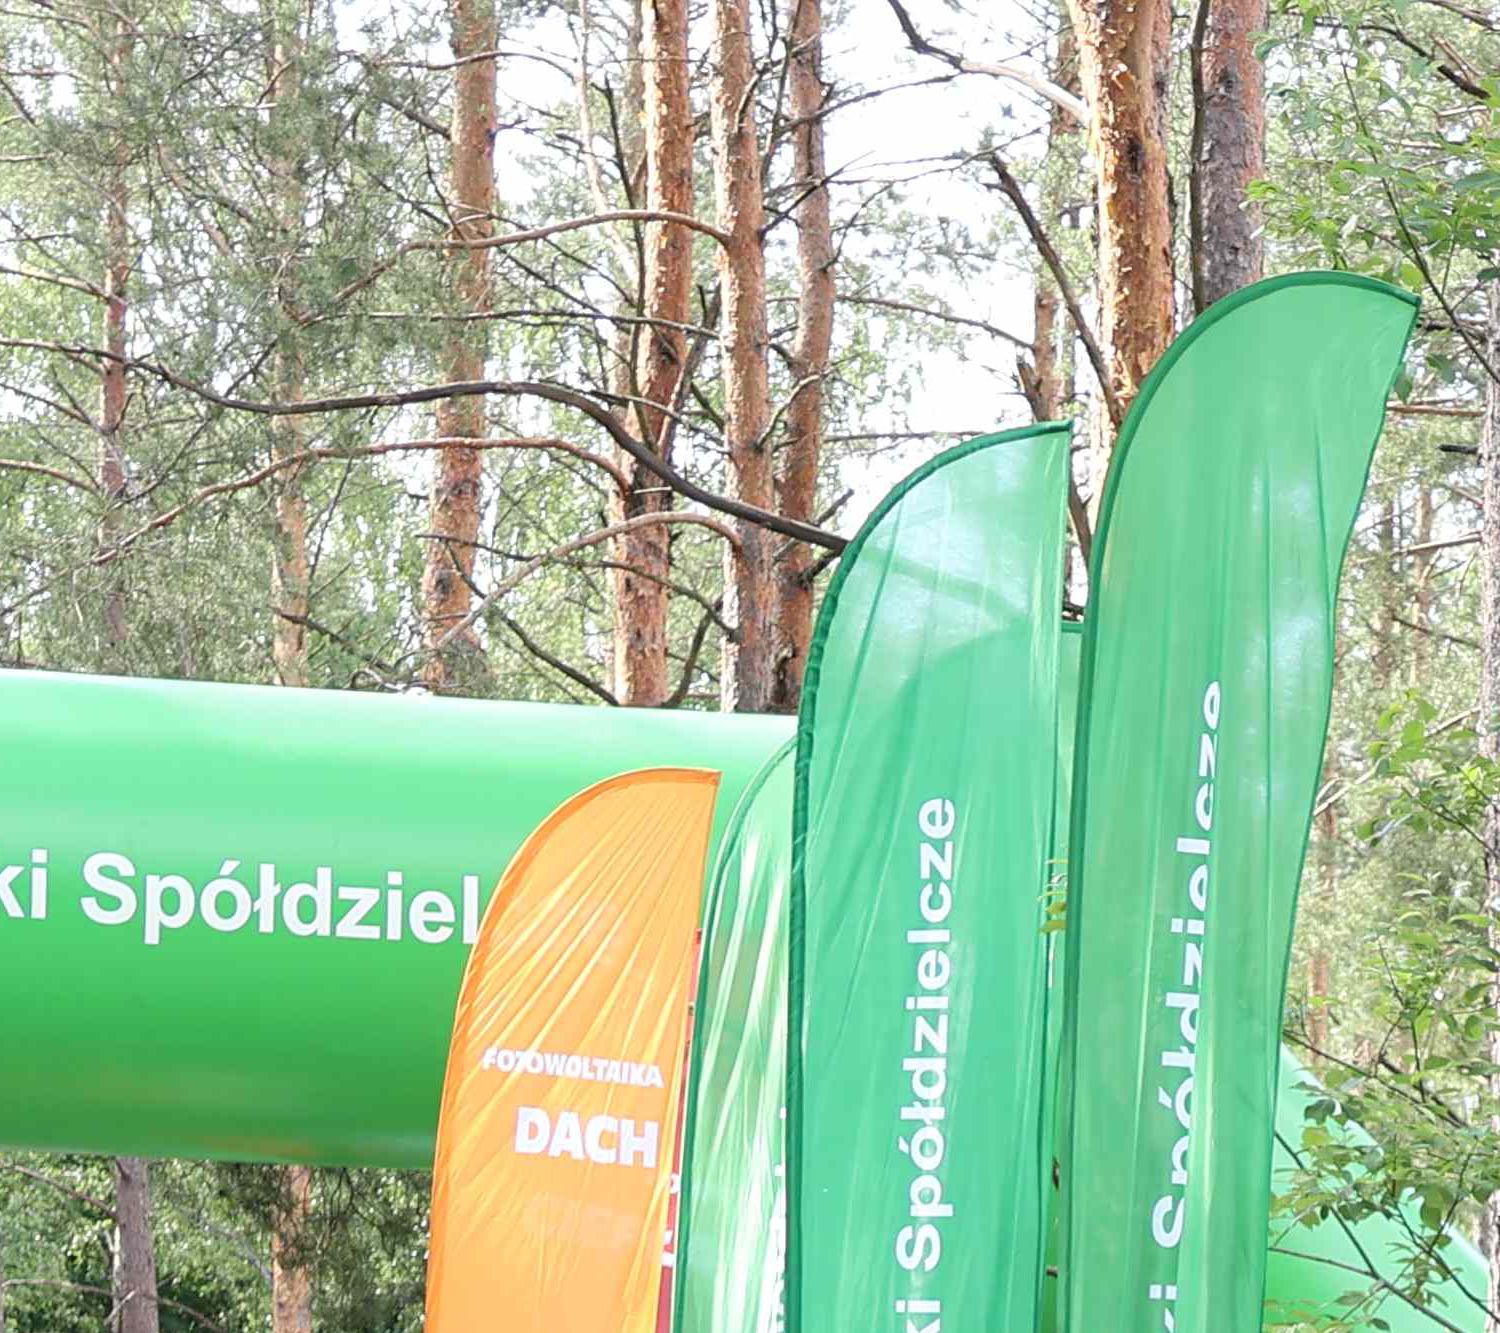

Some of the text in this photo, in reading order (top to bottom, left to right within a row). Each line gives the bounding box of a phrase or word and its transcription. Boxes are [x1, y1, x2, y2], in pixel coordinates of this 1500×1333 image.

[80, 849, 482, 947] Spółdziel
[481, 1046, 665, 1089] FOTOWOLTAIKA
[895, 797, 956, 1272] Spółdzielcze
[514, 1105, 660, 1169] DACH
